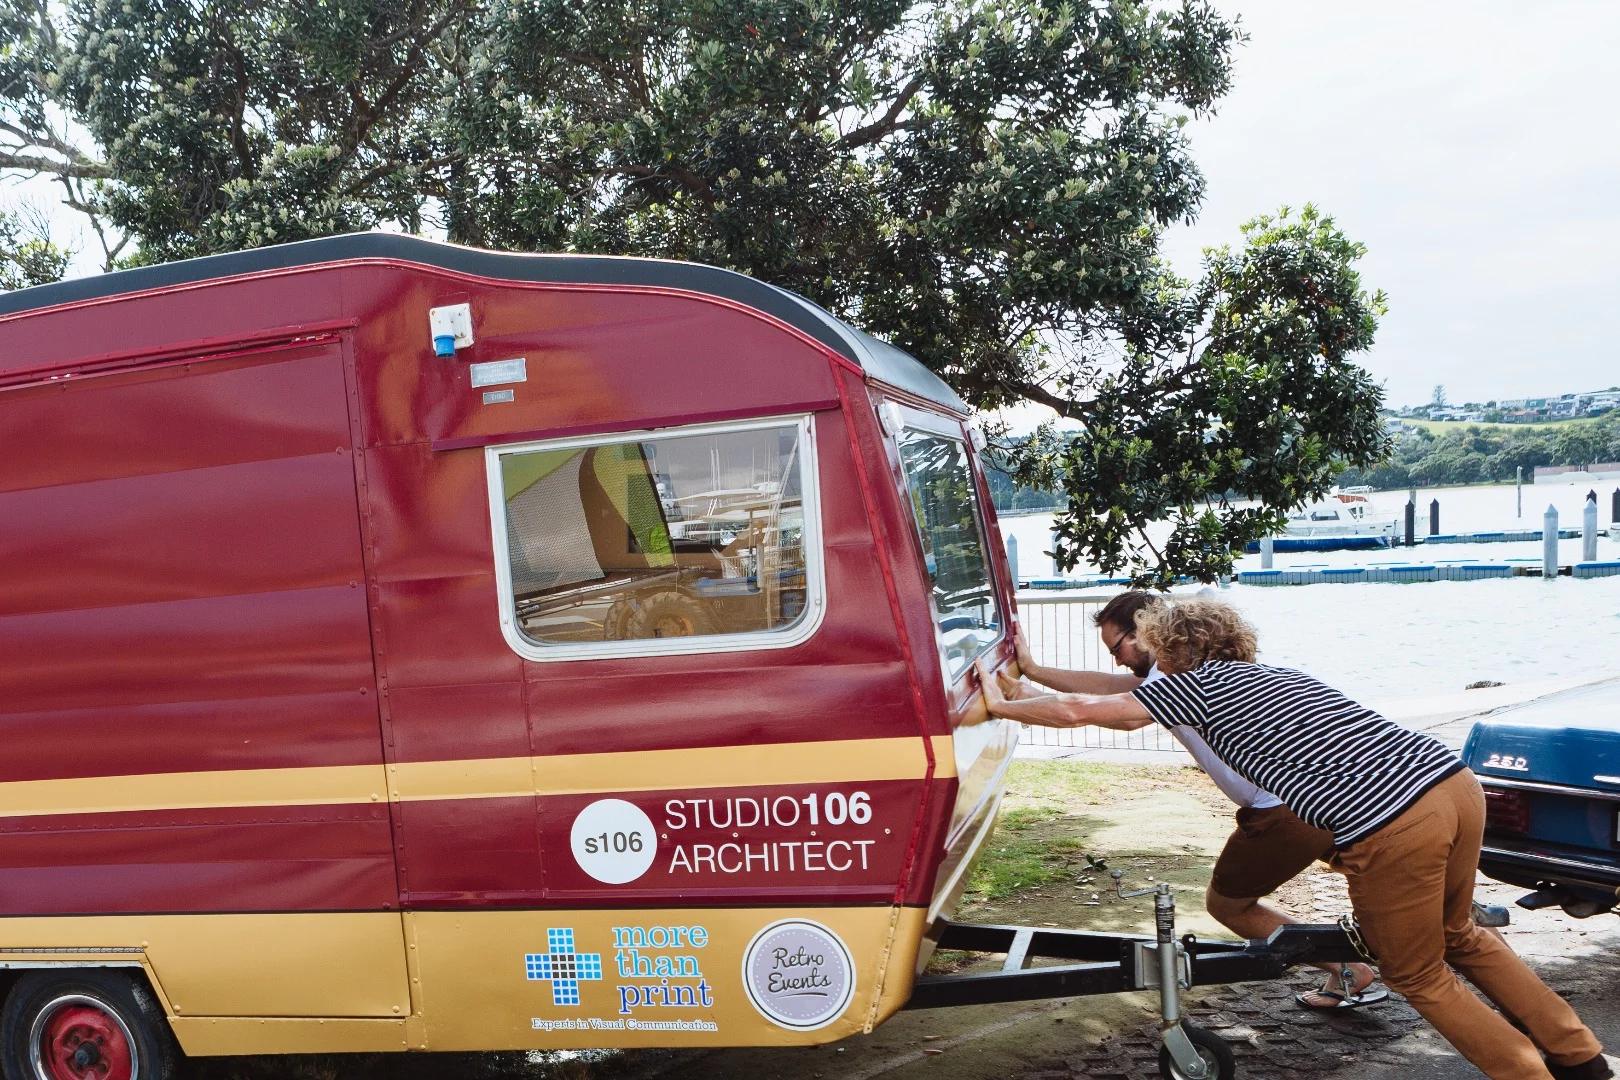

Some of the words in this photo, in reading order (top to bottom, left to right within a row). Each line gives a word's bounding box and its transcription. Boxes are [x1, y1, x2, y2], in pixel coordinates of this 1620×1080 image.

[1488, 754, 1527, 768] 250
[665, 791, 873, 830] STUDIO106
[584, 831, 644, 854] s106
[669, 840, 876, 874] ARCHITECT
[612, 925, 709, 948] more
[615, 949, 703, 977] than
[772, 945, 825, 970] Retro
[767, 967, 832, 993] Events
[617, 978, 714, 1014] print
[532, 1018, 575, 1031] Experts
[576, 1018, 589, 1029] in
[589, 1019, 625, 1030] Visual
[626, 1019, 718, 1031] Communication
